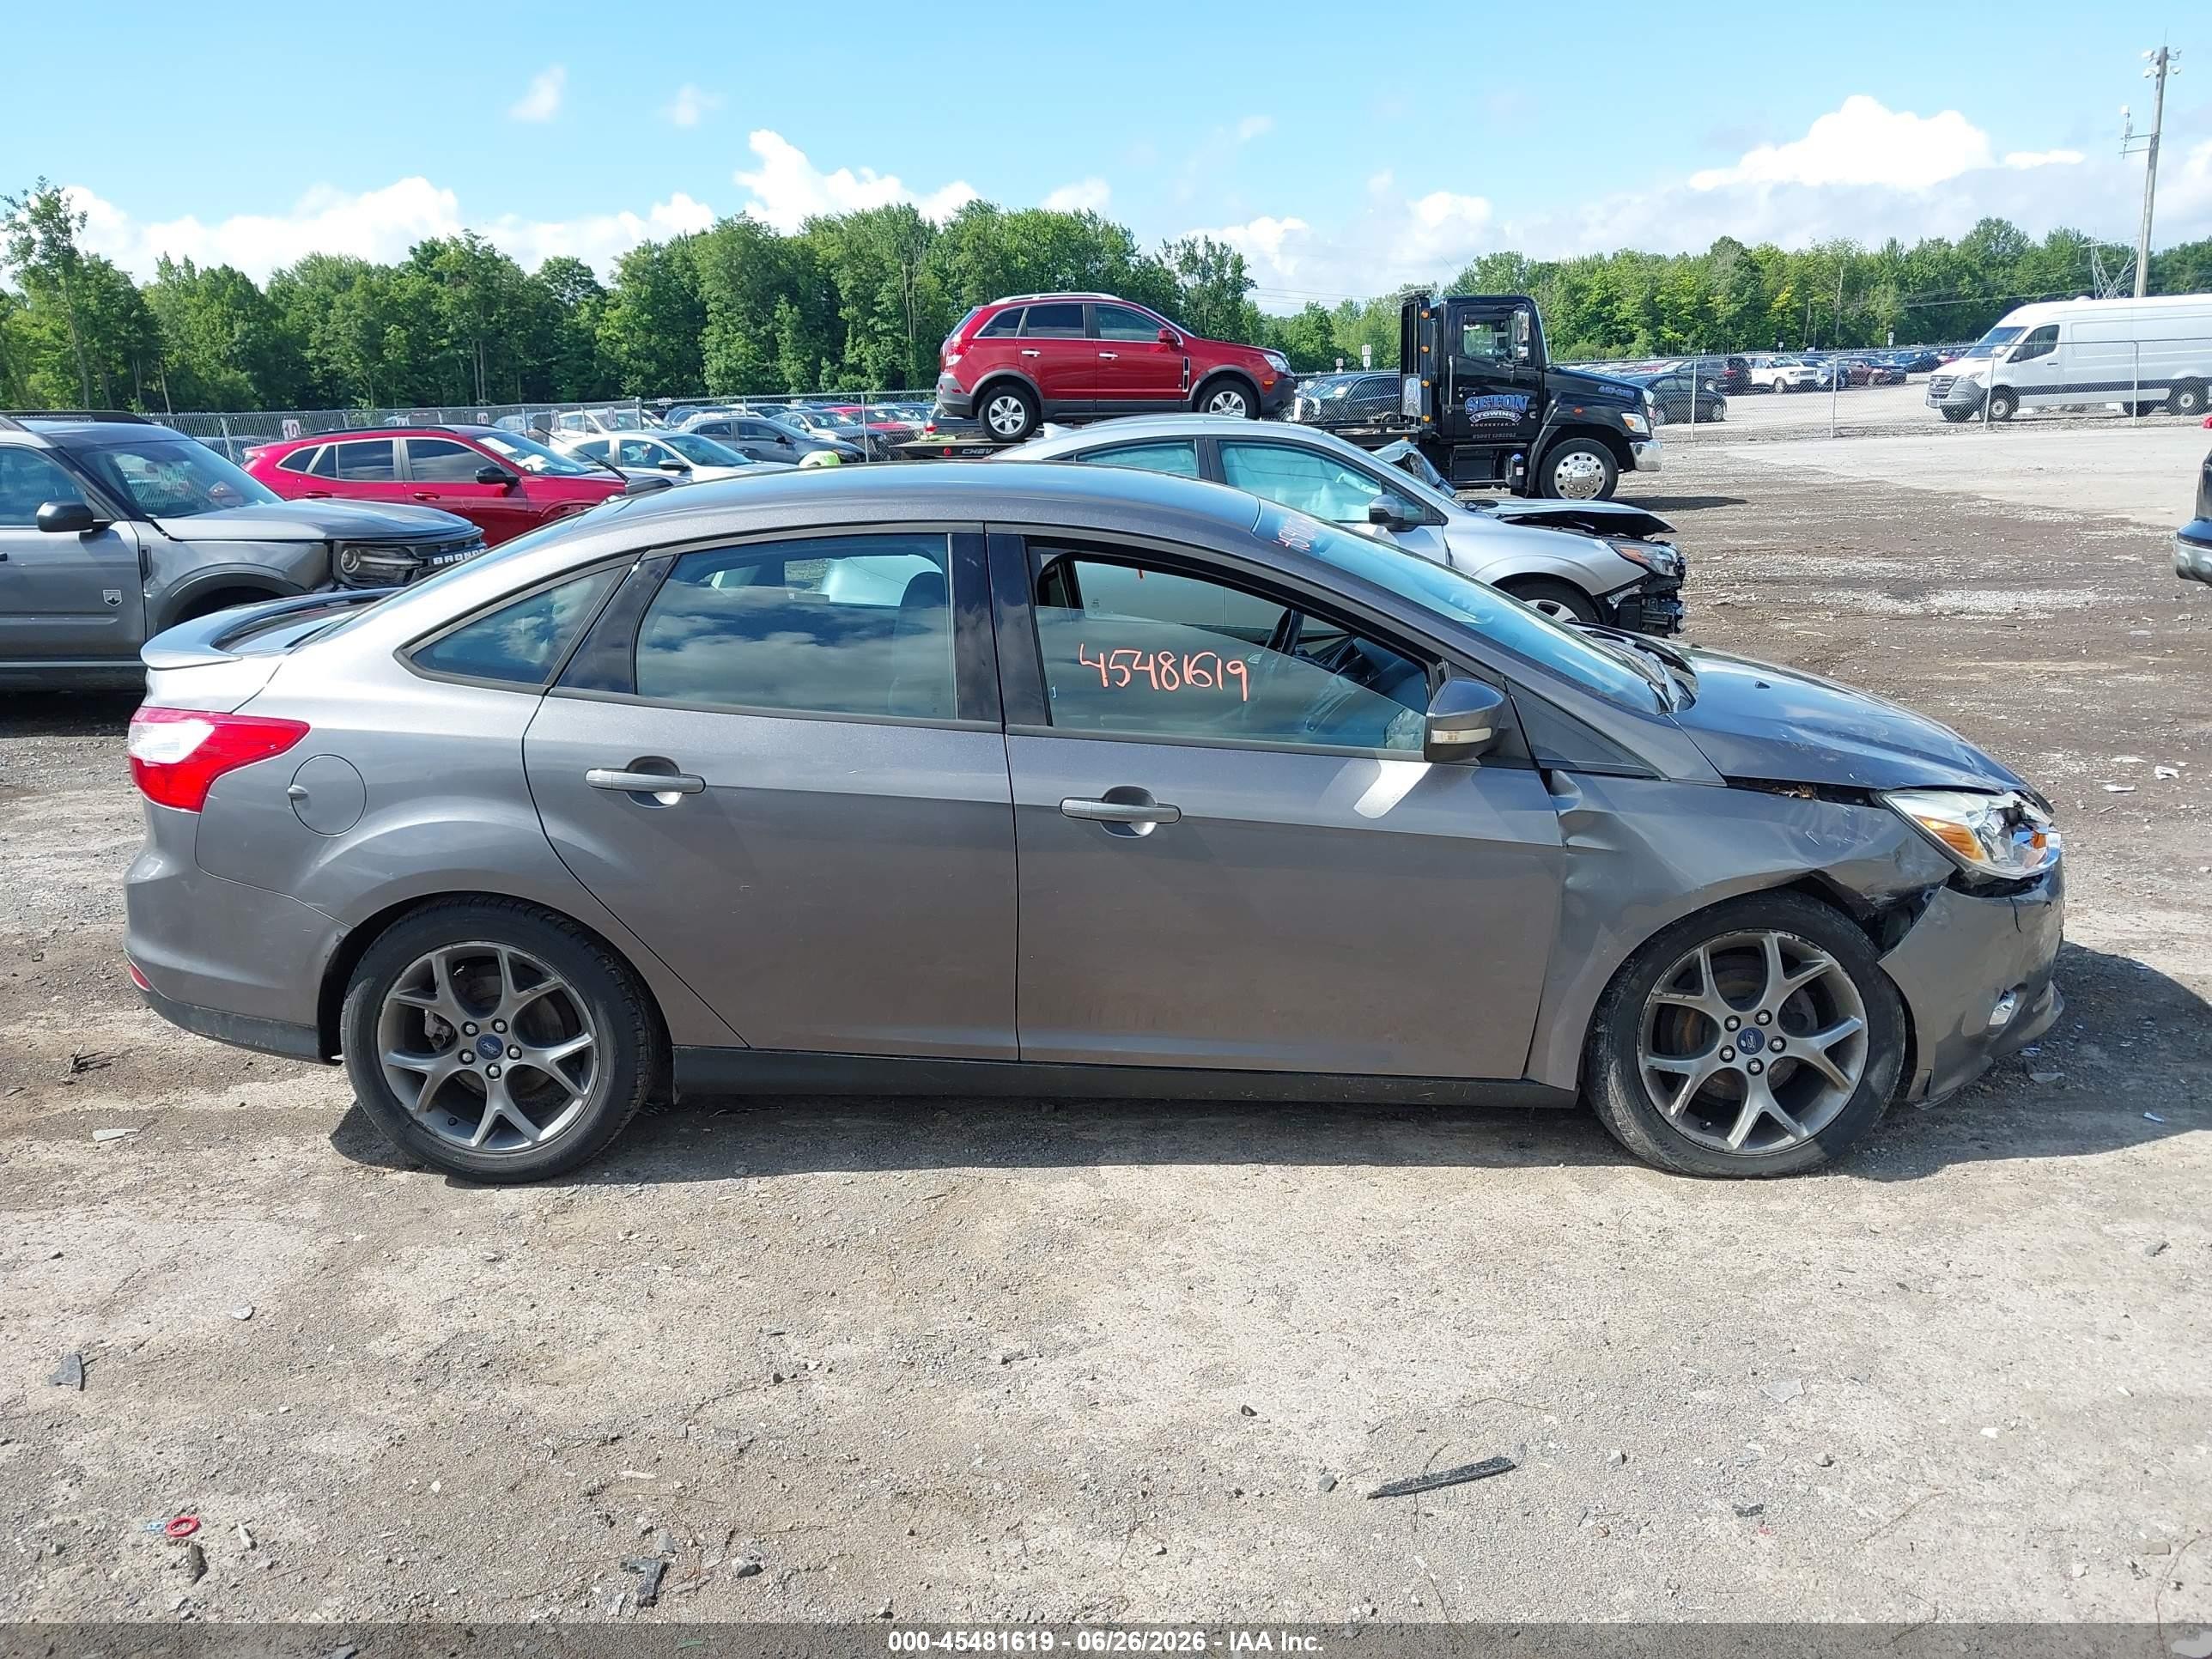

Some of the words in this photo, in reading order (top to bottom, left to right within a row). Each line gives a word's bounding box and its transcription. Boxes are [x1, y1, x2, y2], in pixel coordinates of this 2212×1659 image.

[1464, 394, 1530, 415] SETON
[1475, 410, 1516, 419] TOWING
[1079, 642, 1249, 702] 45481619
